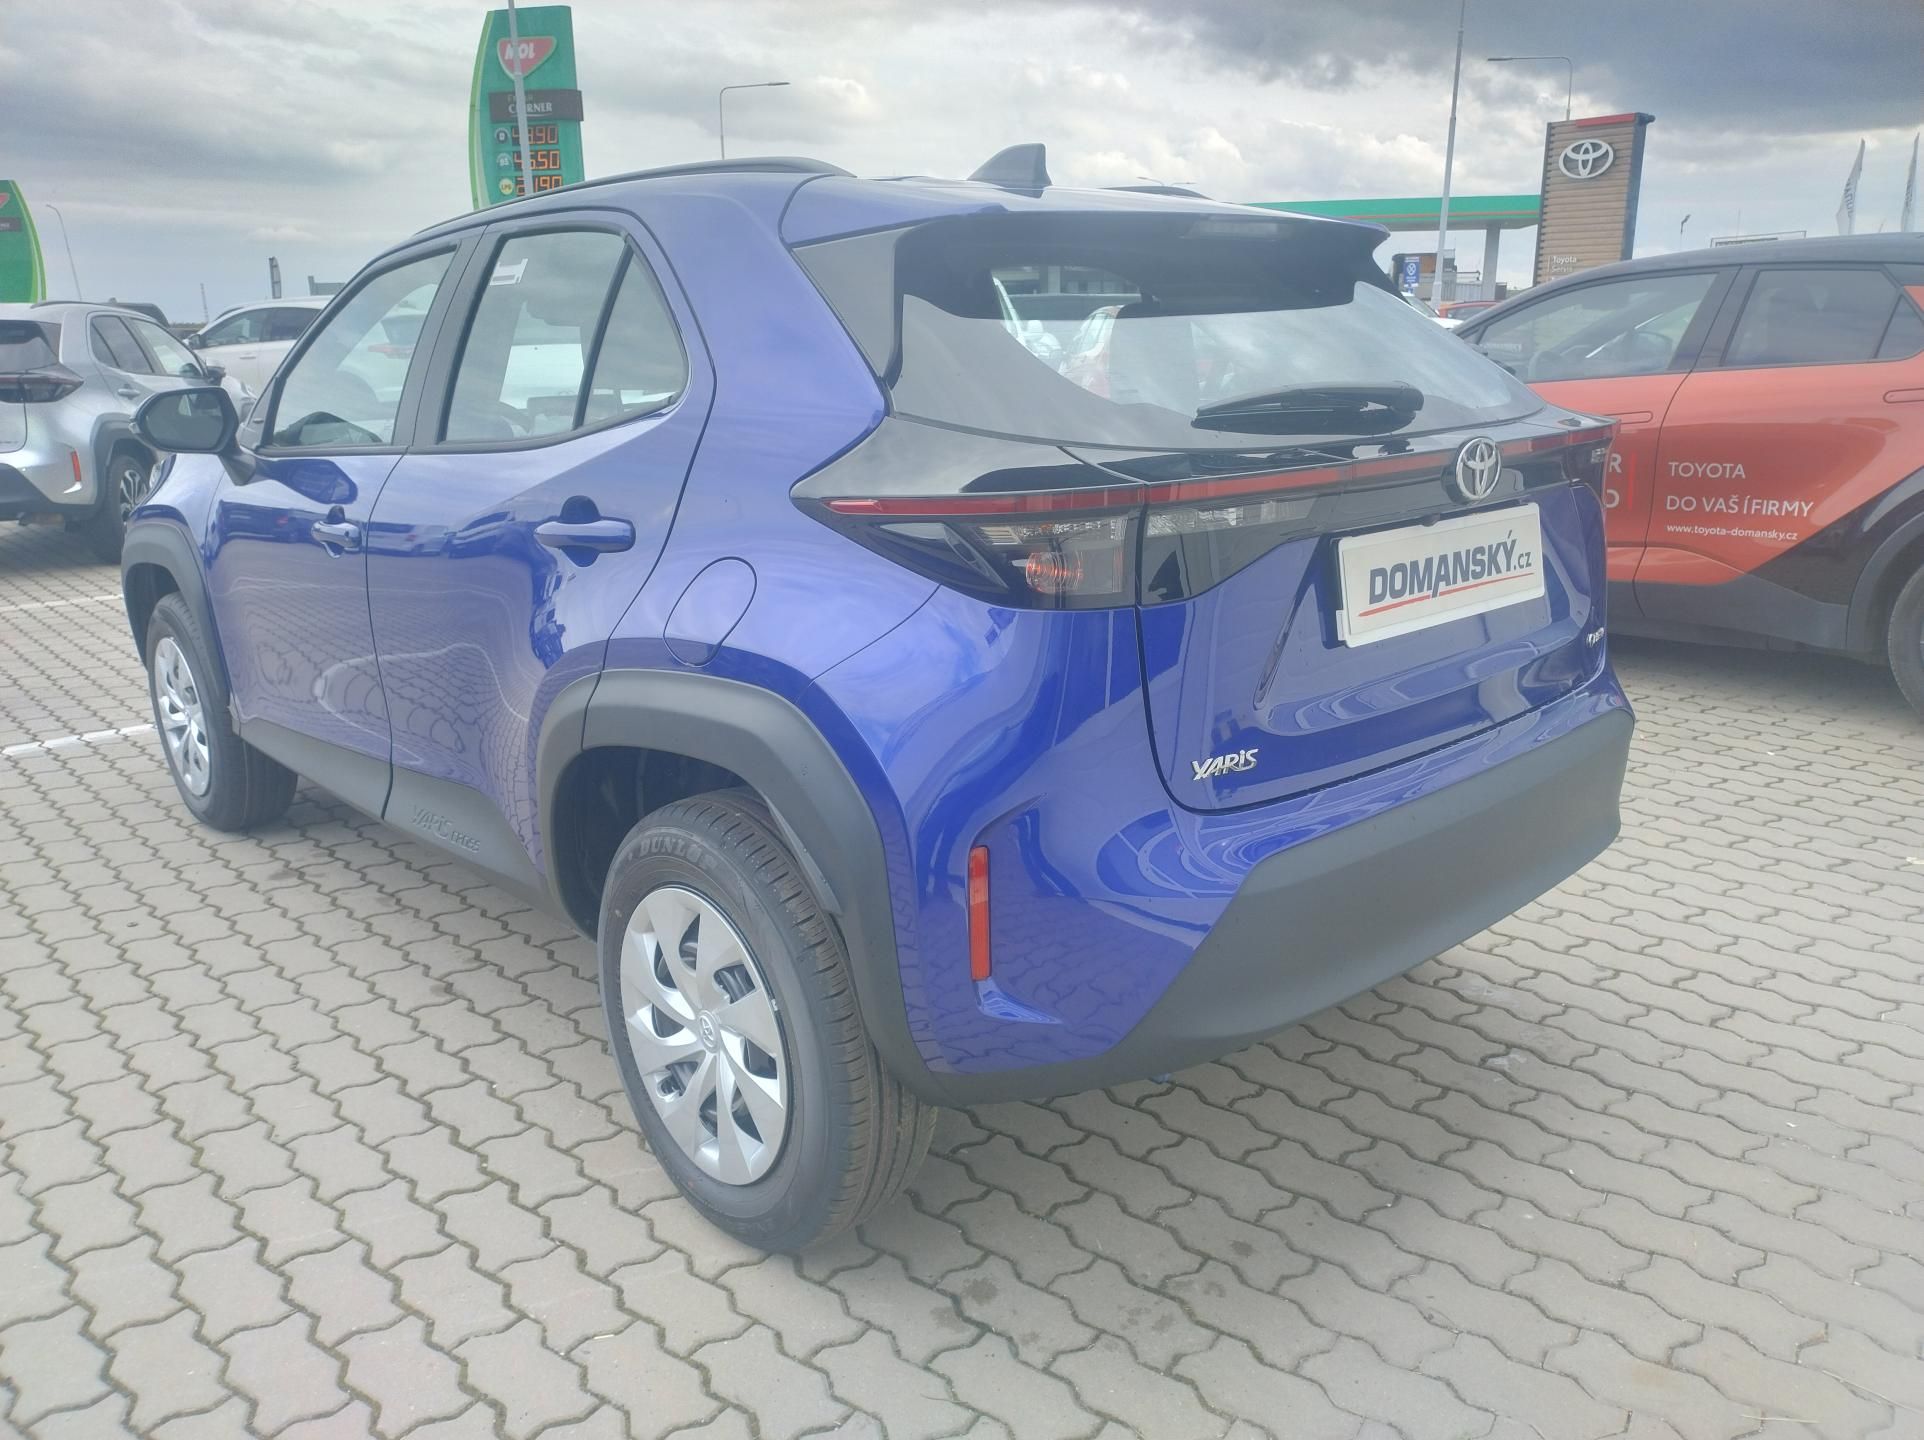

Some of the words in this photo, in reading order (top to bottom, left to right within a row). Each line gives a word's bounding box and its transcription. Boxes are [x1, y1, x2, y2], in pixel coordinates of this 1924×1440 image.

[508, 102, 553, 114] CRNER
[1552, 255, 1577, 265] Toyota
[1668, 462, 1746, 479] TOYOTA
[1666, 495, 1697, 511] DO
[1666, 524, 1798, 540] www.toyota-domansky.cz
[1191, 748, 1259, 781] YARIS
